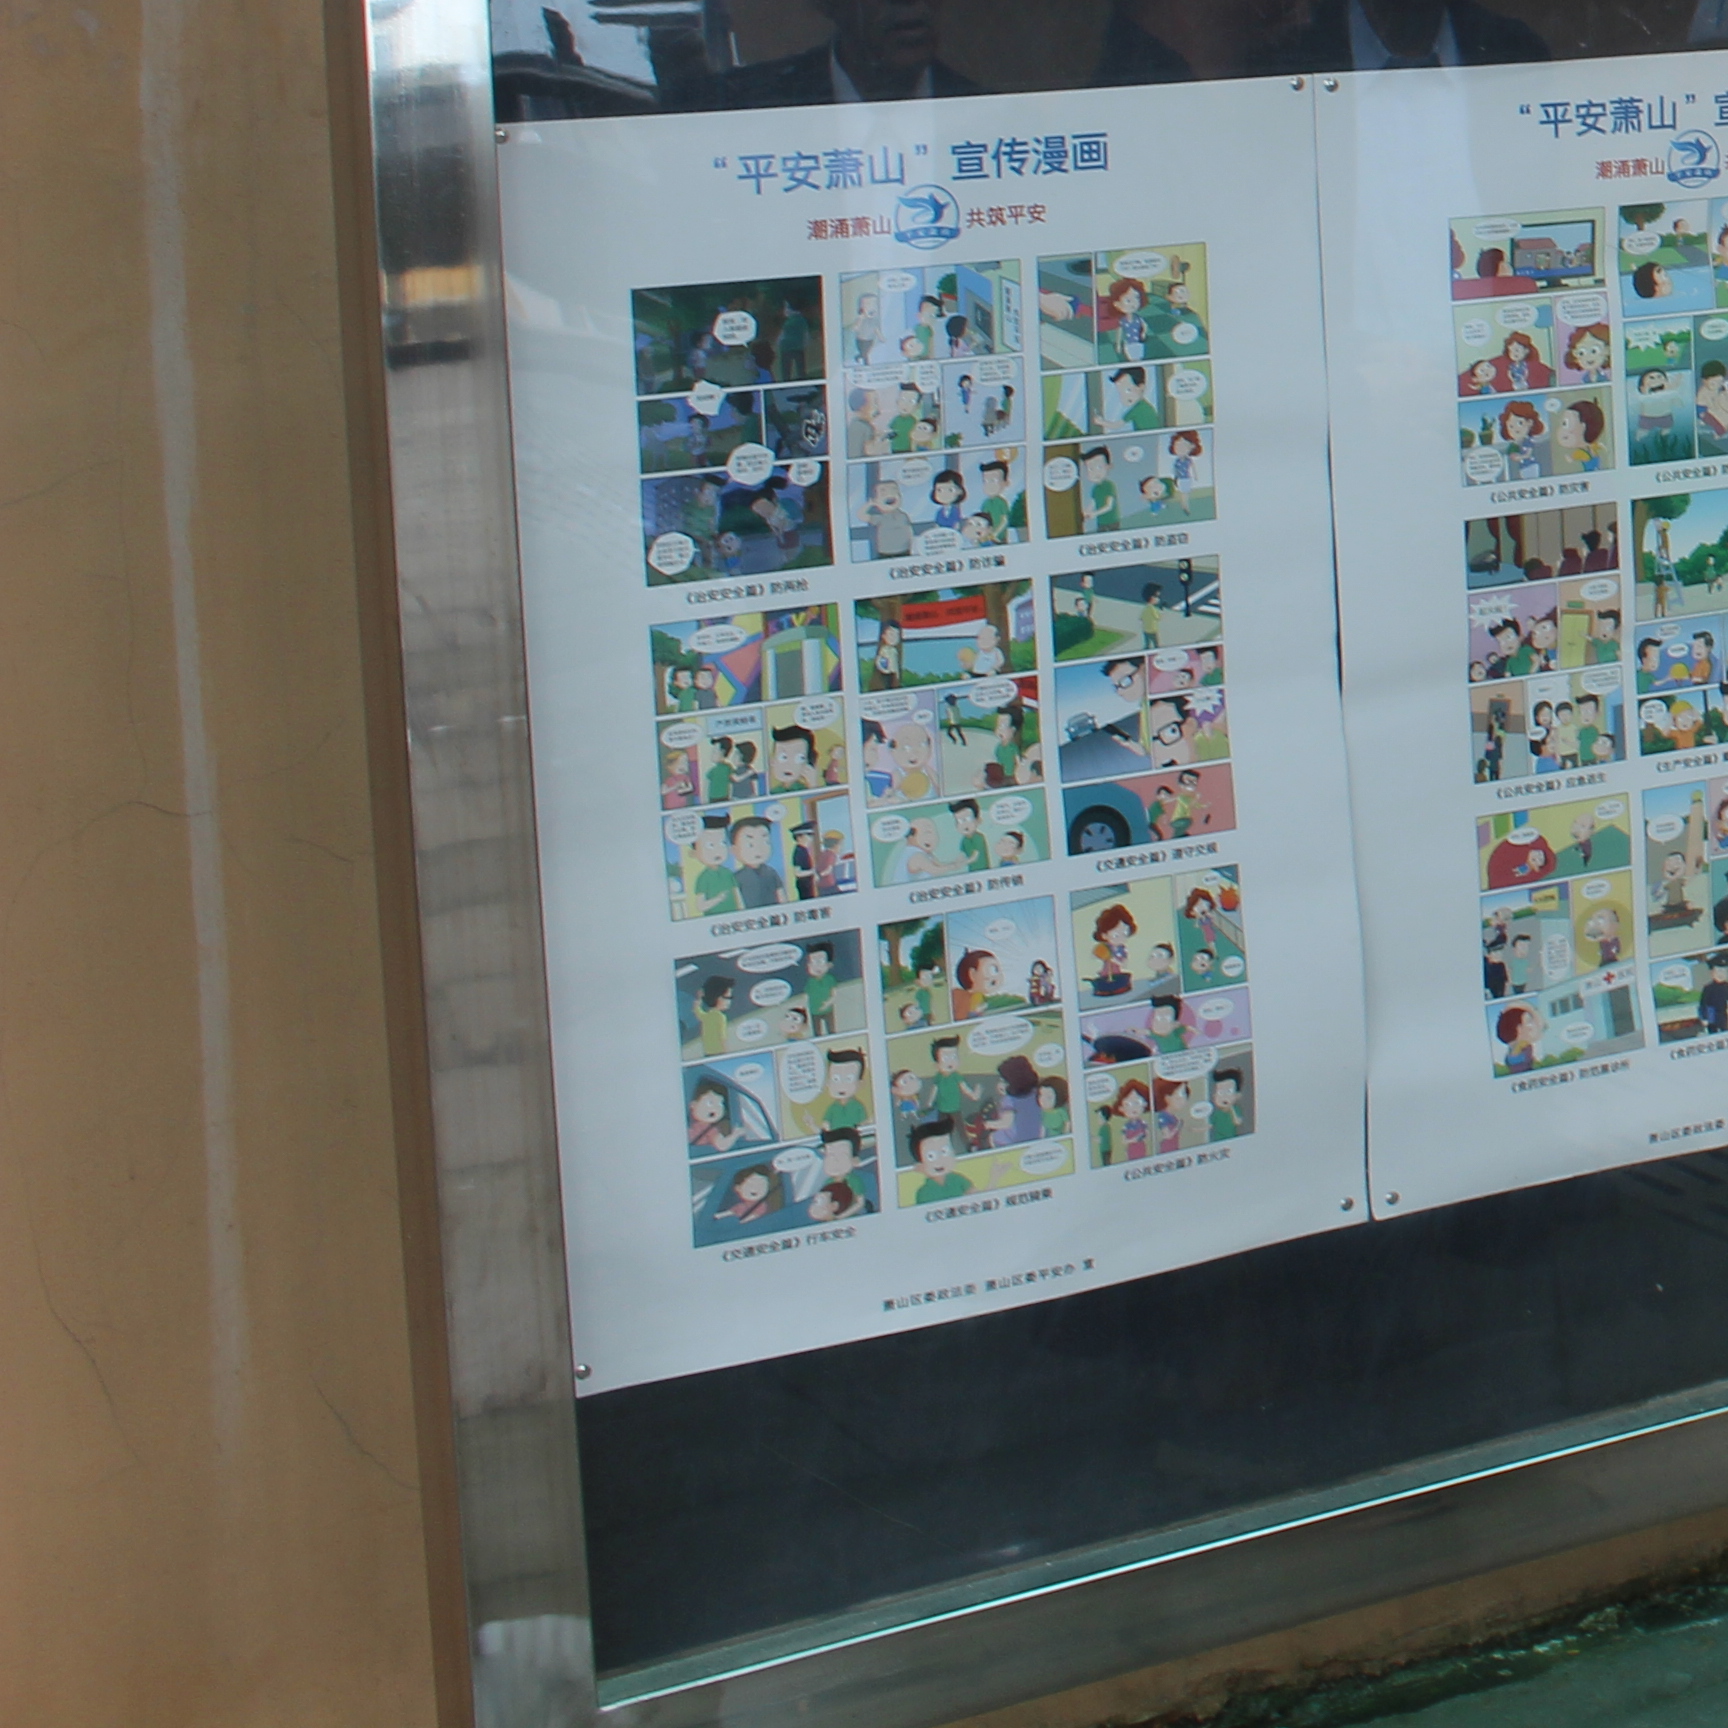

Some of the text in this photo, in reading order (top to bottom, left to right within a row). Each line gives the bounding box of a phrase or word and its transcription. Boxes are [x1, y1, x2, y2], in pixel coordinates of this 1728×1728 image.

[1595, 157, 1665, 180] 潮涌萧山
[806, 202, 1047, 241] 潮涌萧山 共筑平安
